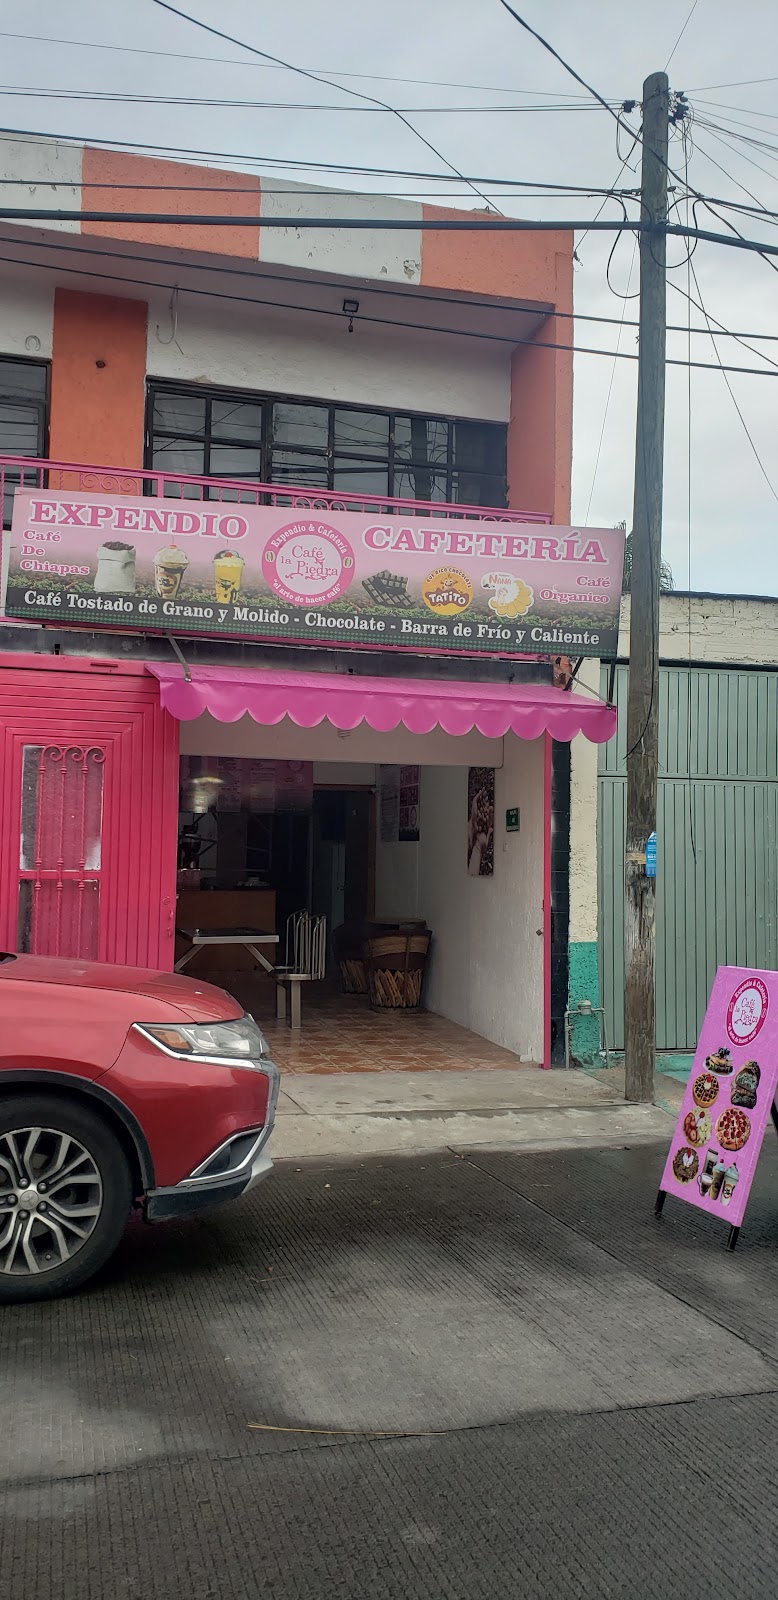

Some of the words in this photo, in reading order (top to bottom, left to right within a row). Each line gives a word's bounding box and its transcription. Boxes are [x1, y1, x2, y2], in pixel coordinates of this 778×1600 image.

[31, 501, 247, 538] EXPENDIO
[24, 530, 61, 542] Café
[271, 525, 306, 548] Expendio
[308, 523, 315, 532] &
[317, 525, 348, 554] Cafetería
[22, 545, 45, 556] De
[291, 545, 324, 559] Café
[365, 526, 607, 563] CAFETERÍA
[21, 560, 89, 575] Chiapas
[280, 556, 292, 564] la
[297, 560, 338, 577] Piedra
[576, 576, 611, 588] Café
[279, 588, 294, 600] arte
[305, 596, 326, 604] hacer
[24, 591, 62, 607] Café
[66, 593, 134, 612] Tostado
[138, 599, 158, 614] de
[162, 601, 214, 618] Grano
[217, 608, 229, 622] y
[232, 606, 290, 625] Molido
[304, 612, 386, 631] Chocolate
[400, 619, 449, 636] Barra
[453, 623, 472, 637] de
[476, 624, 512, 640] Frío
[515, 629, 527, 644] y
[530, 627, 600, 645] Caliente
